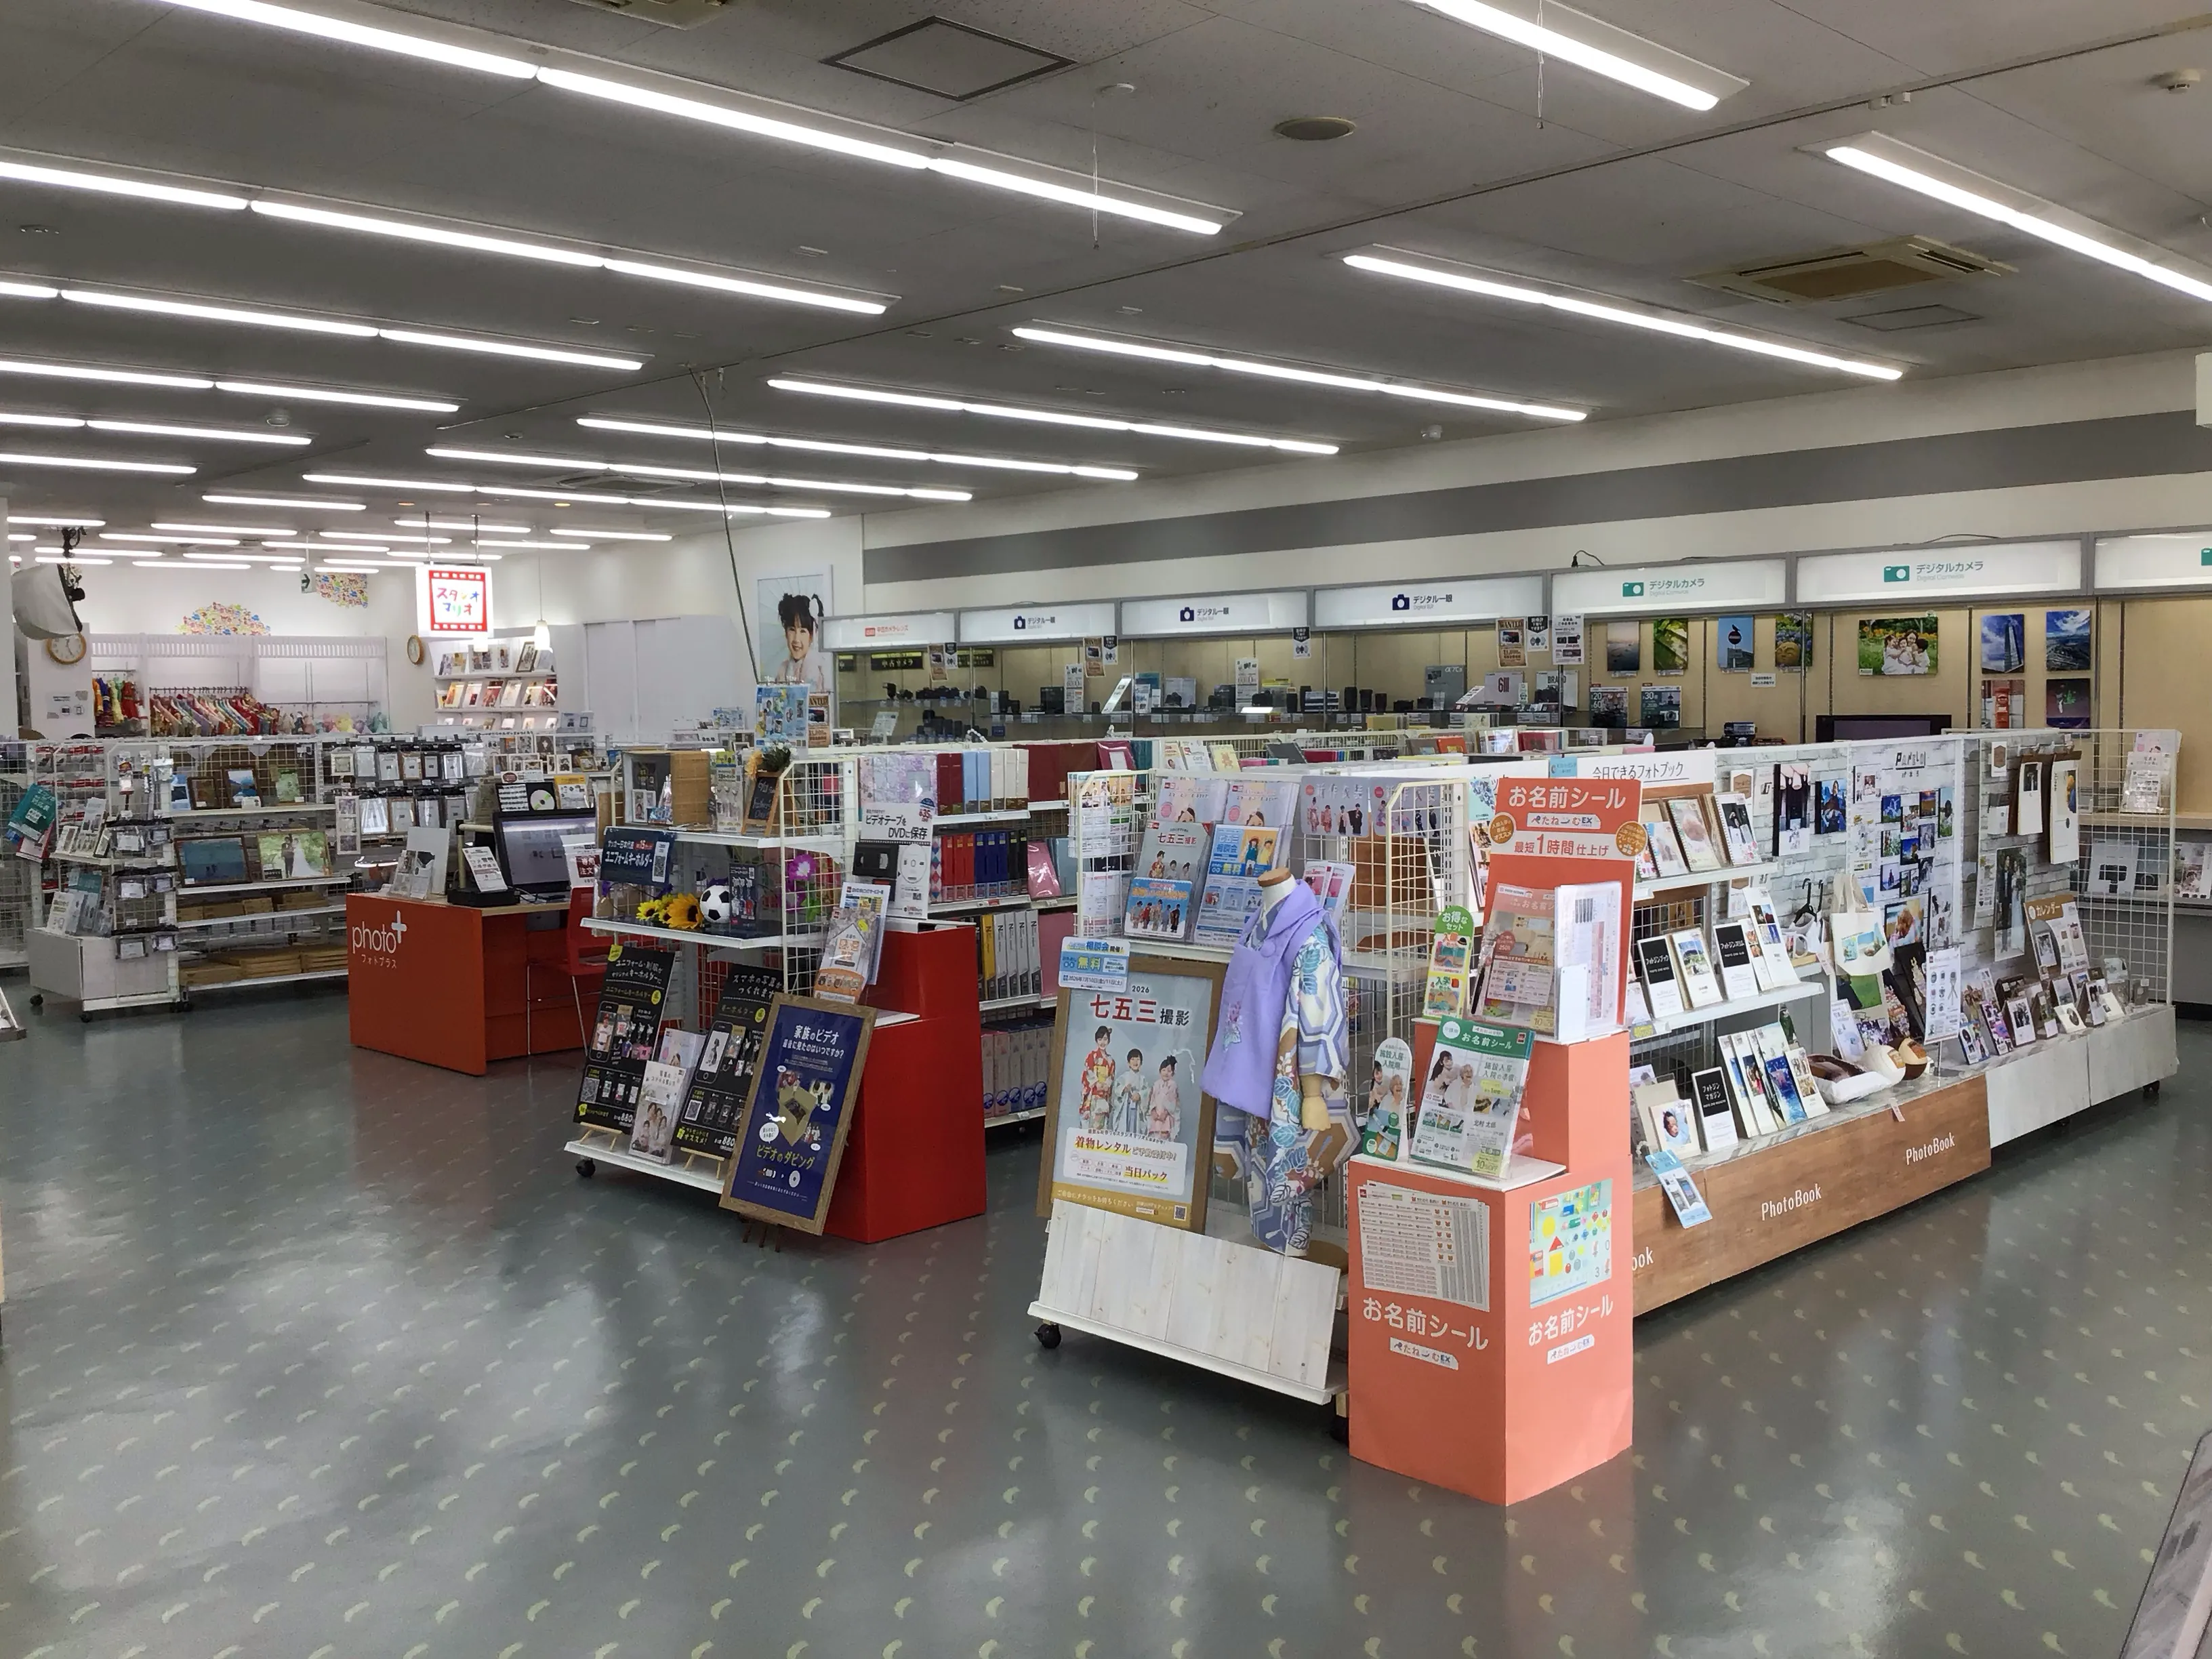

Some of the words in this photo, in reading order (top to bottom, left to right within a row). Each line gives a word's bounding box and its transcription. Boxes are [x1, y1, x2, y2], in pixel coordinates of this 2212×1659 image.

[1917, 560, 1984, 573] デジタルカメラ
[1650, 578, 1705, 590] デジタルカメラ
[1413, 594, 1452, 605] デジタル一眼
[1509, 785, 1626, 809] お名前シール
[865, 815, 907, 826] ビデオテープを
[888, 827, 928, 840] DVDに保存
[1515, 834, 1609, 857] 最短1時間仕上げ
[1442, 910, 1469, 924] お得な
[361, 954, 397, 969] フォトプラス
[1078, 956, 1101, 970] 無料
[1132, 985, 1150, 994] 2026
[1090, 994, 1189, 1026] 七五三撮影
[794, 1024, 840, 1045] 家族のビデオ
[1461, 1033, 1512, 1050] お名前シール
[1906, 1132, 1956, 1166] PhotoBook
[756, 1145, 816, 1170] ビデオのダビング
[1125, 1165, 1168, 1181] 当日パック
[1761, 1183, 1822, 1221] PhotoBook
[1363, 1296, 1489, 1351] お名前シール
[1529, 1294, 1614, 1347] お名前シール
